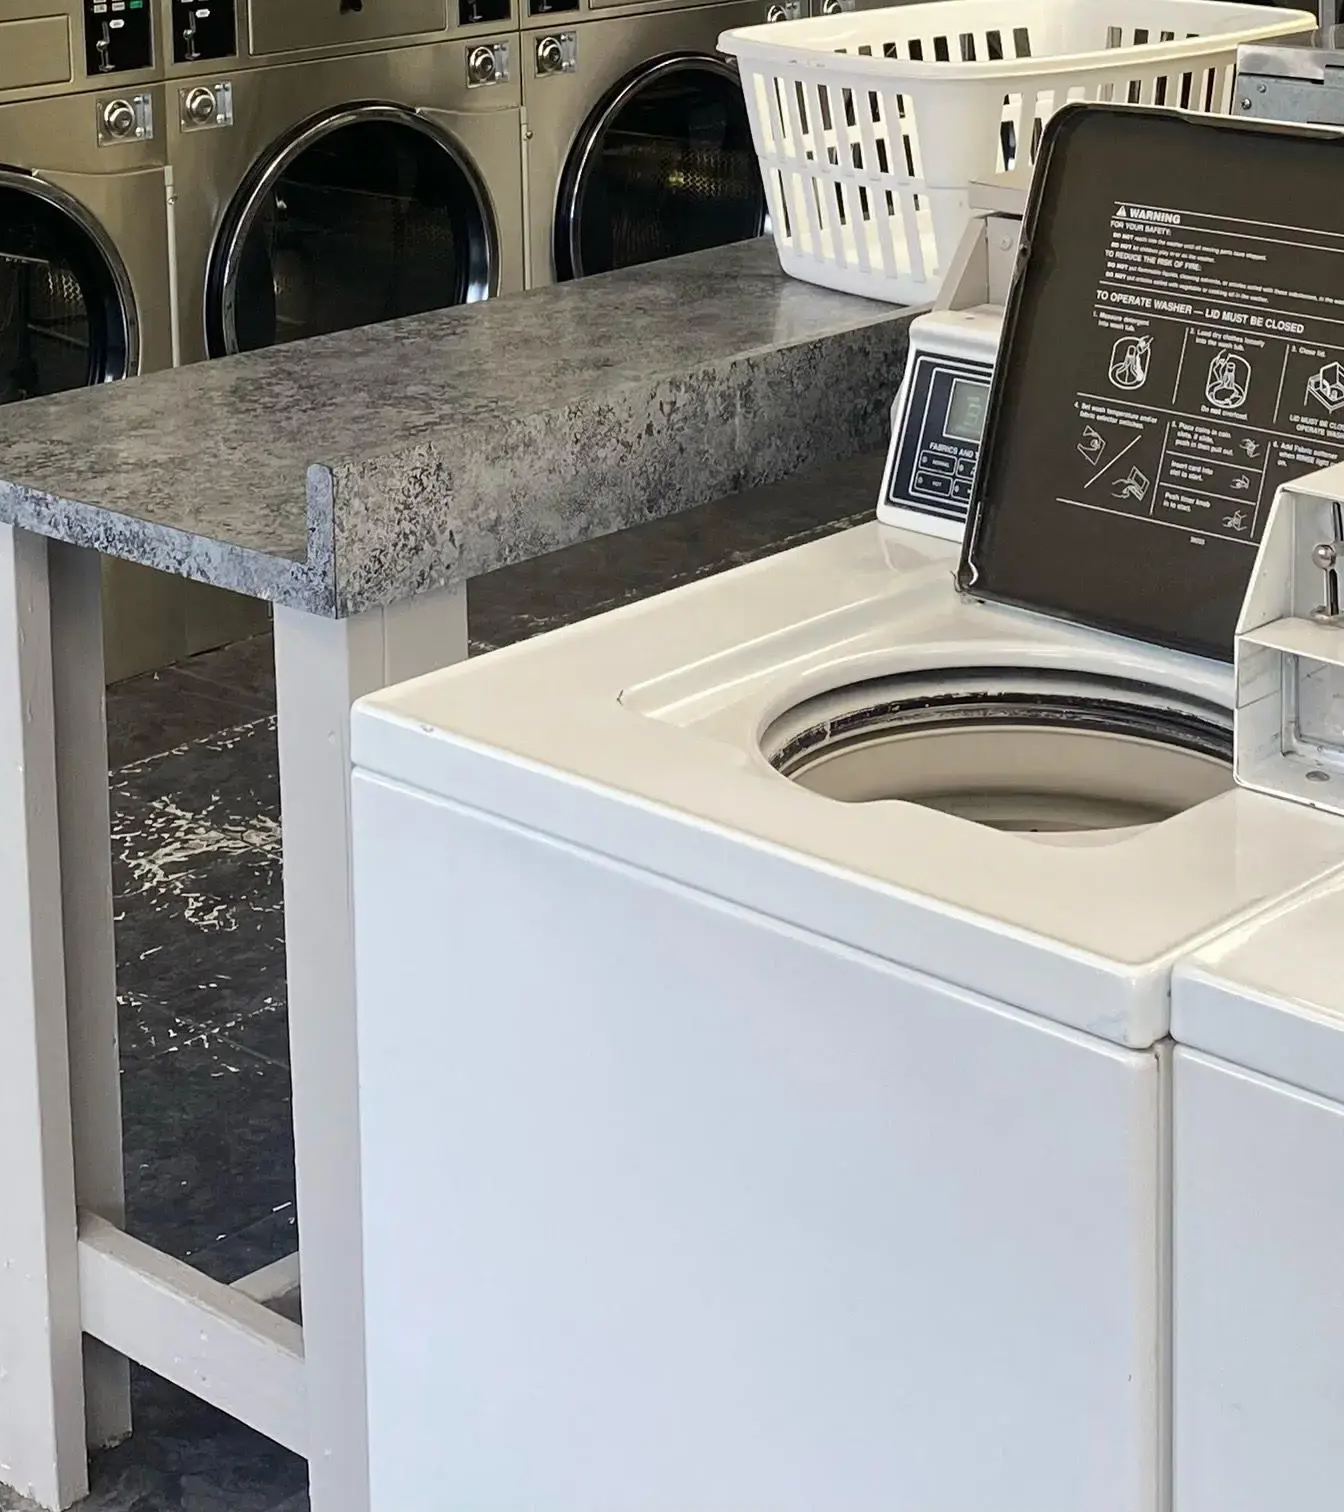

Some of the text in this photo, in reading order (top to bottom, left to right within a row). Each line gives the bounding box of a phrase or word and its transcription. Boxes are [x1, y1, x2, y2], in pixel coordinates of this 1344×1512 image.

[1129, 207, 1180, 224] WARNING
[1096, 289, 1304, 333] TO OPERATE WASHER LID MUST BE CLOSED
